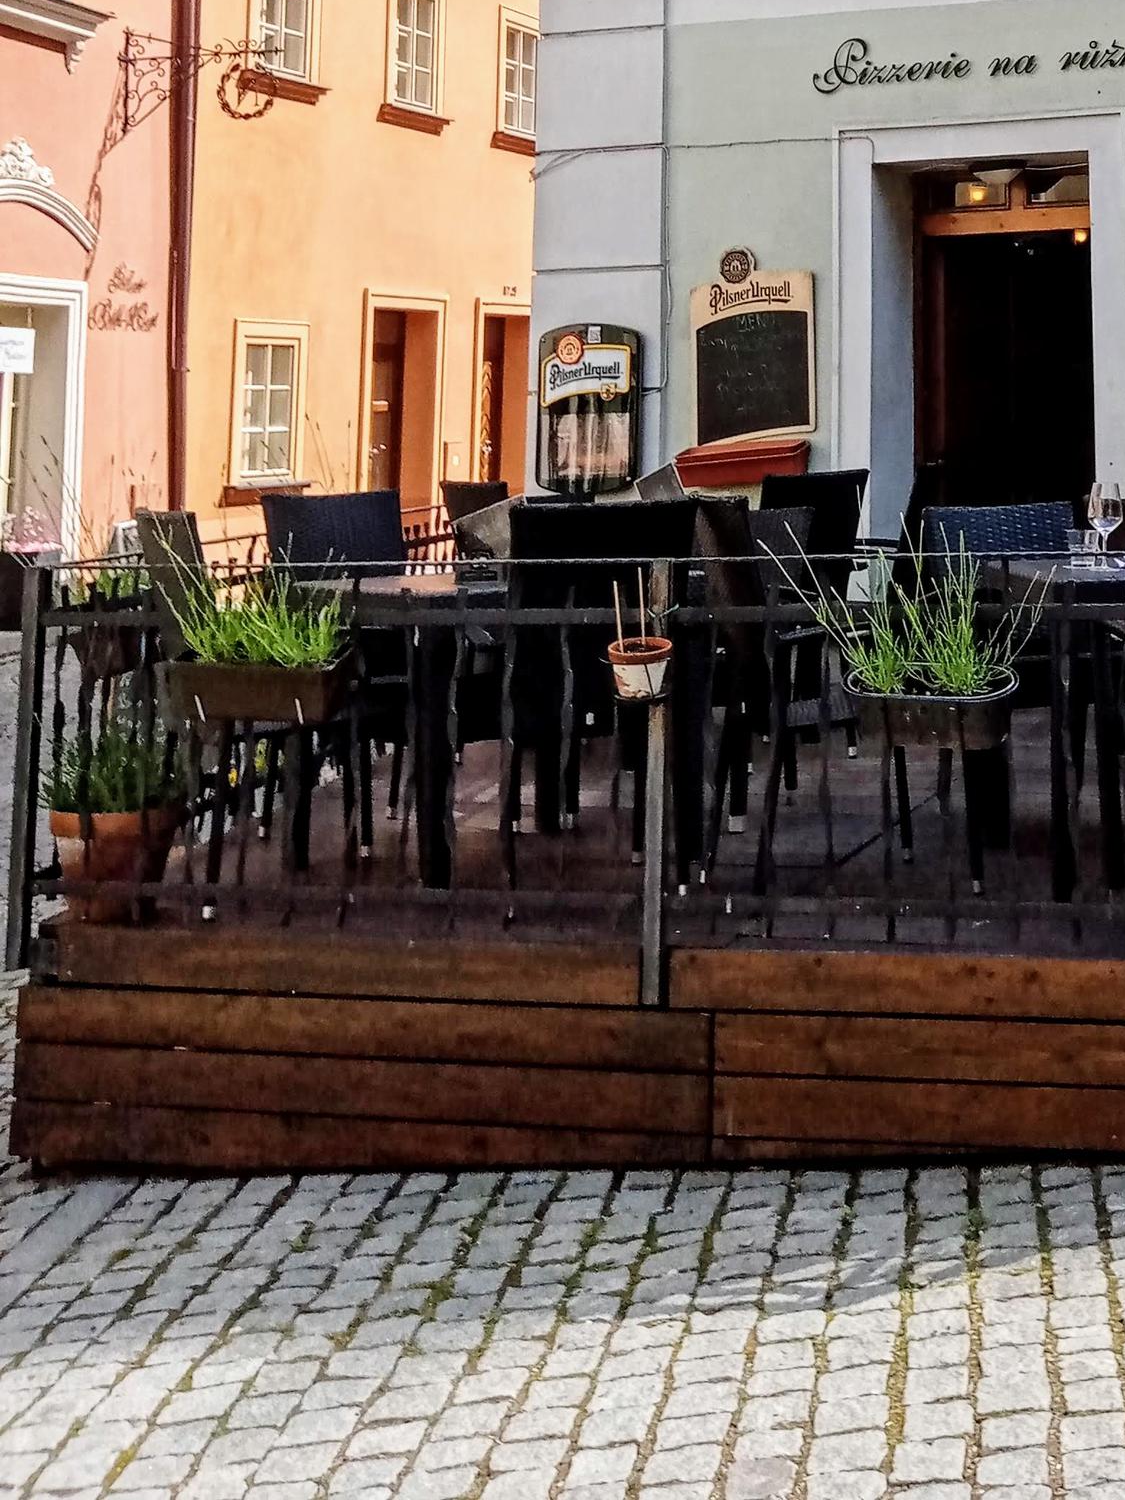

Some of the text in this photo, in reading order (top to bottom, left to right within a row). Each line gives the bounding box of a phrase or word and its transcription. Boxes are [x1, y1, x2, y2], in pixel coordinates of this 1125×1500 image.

[812, 37, 971, 94] Pizzerie
[987, 52, 1038, 77] na
[709, 281, 791, 315] Pilsner Urquell
[549, 361, 621, 390] Pilsner Urquell
